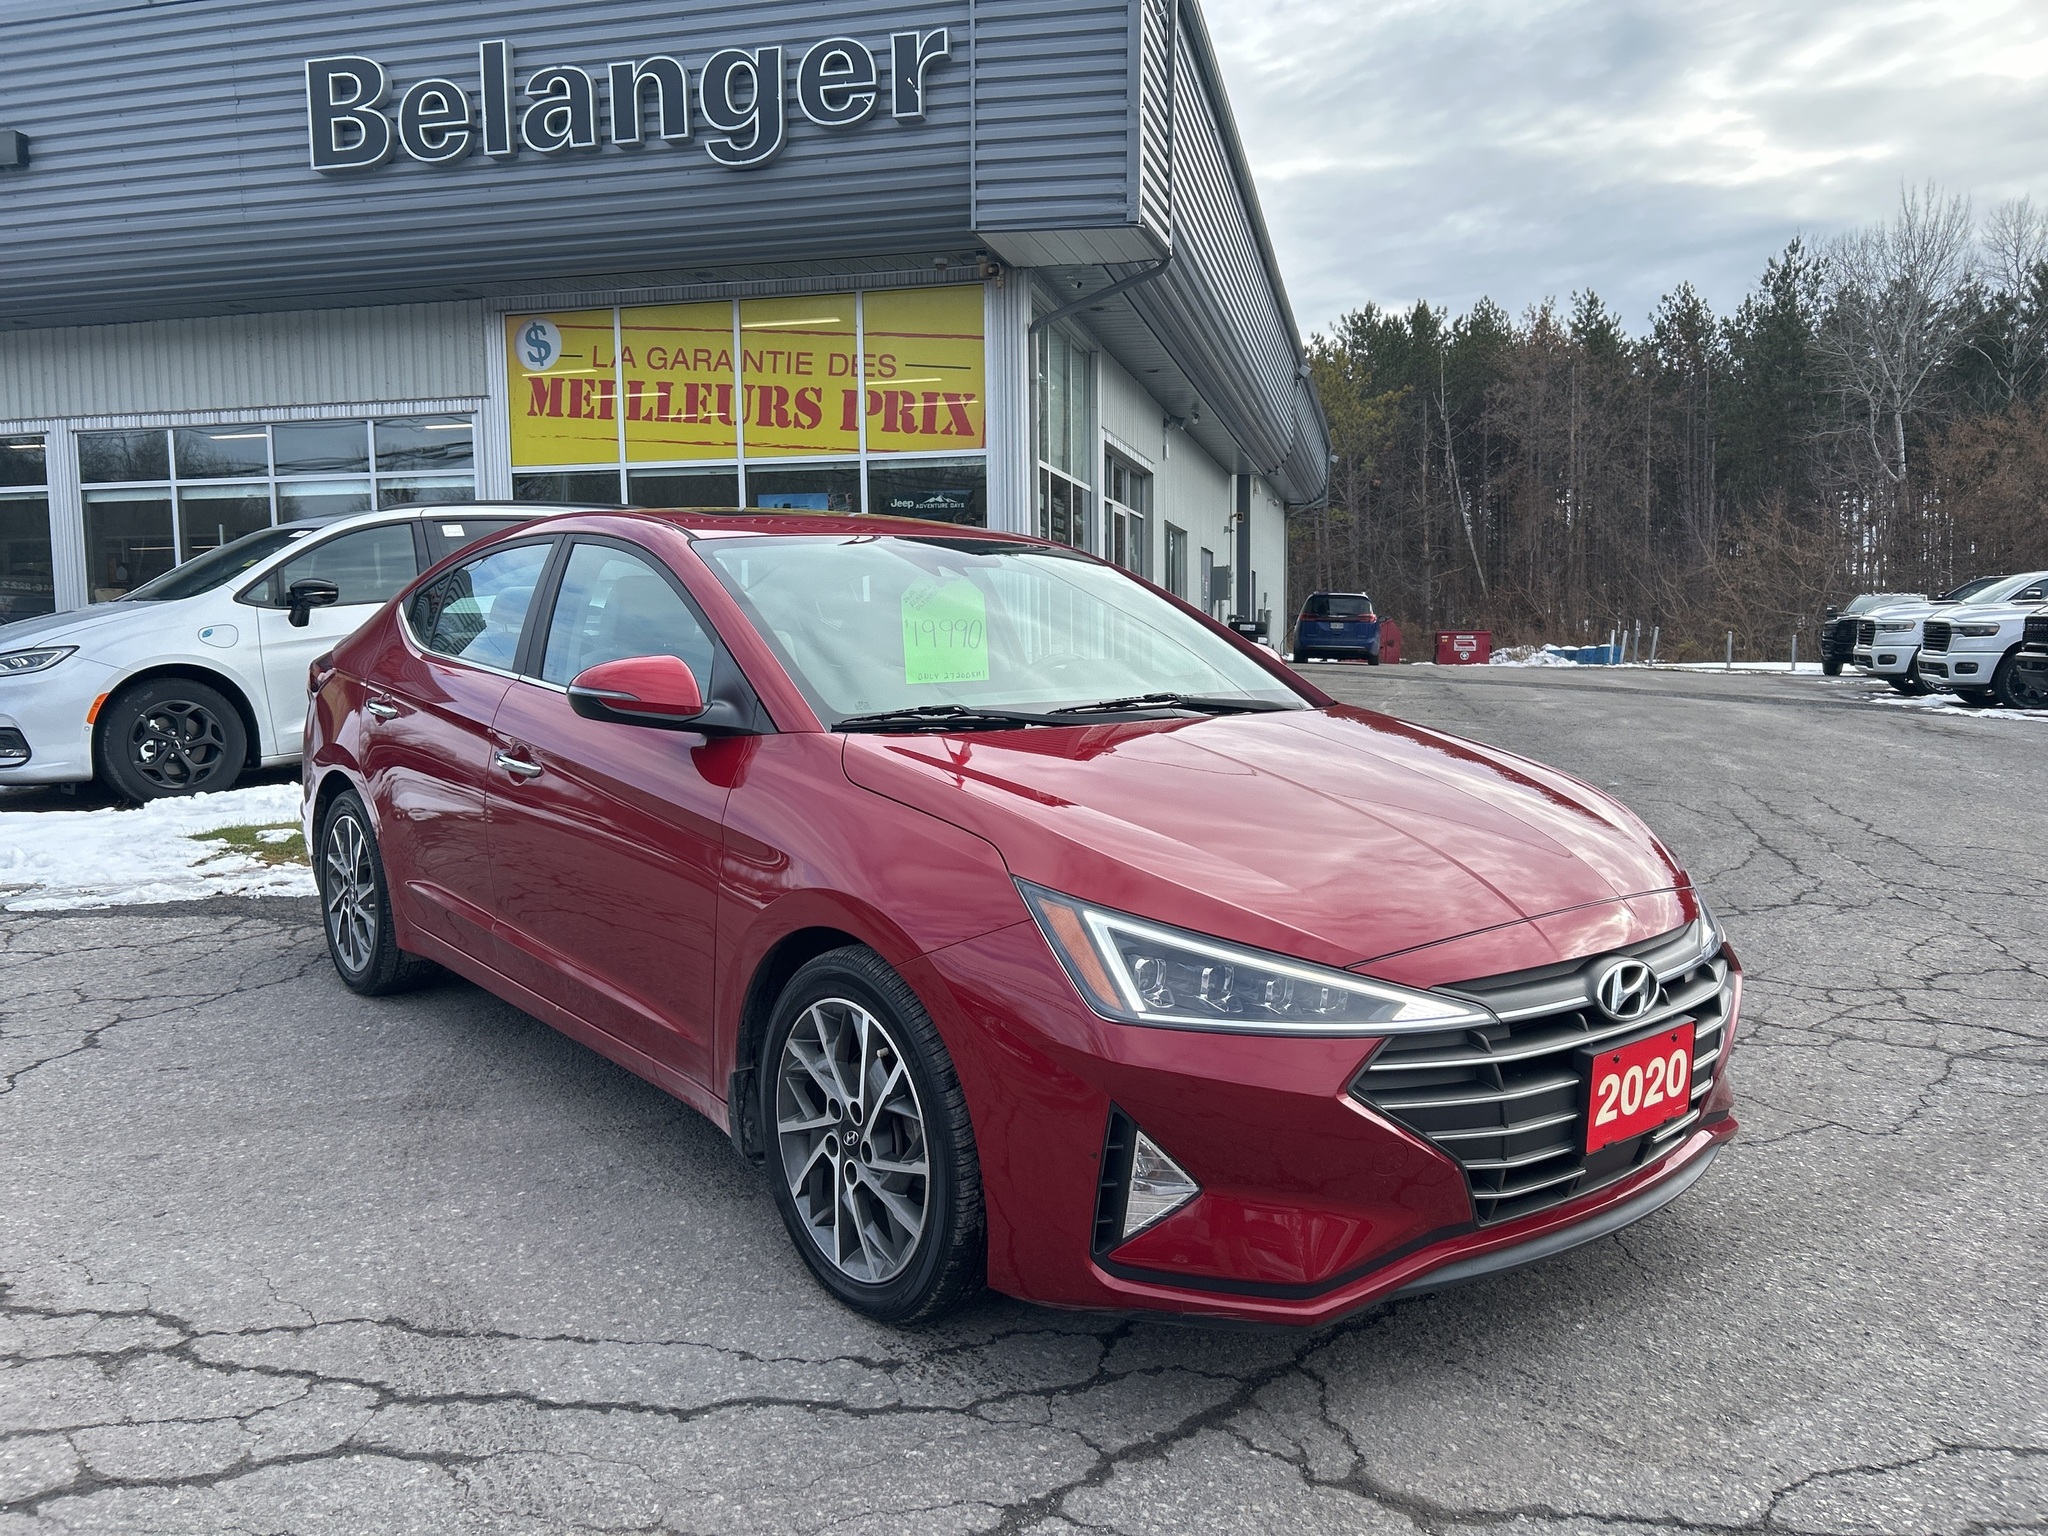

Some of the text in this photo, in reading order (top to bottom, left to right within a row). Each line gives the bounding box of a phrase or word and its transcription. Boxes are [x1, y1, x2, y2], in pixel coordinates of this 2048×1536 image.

[304, 27, 952, 171] Belanger
[592, 345, 897, 378] LA GARANTIE DES
[526, 376, 976, 437] MEILLEURS PRIX
[891, 499, 914, 509] Jeep
[917, 672, 939, 681] ONLY
[1594, 1048, 1688, 1127] 2020
